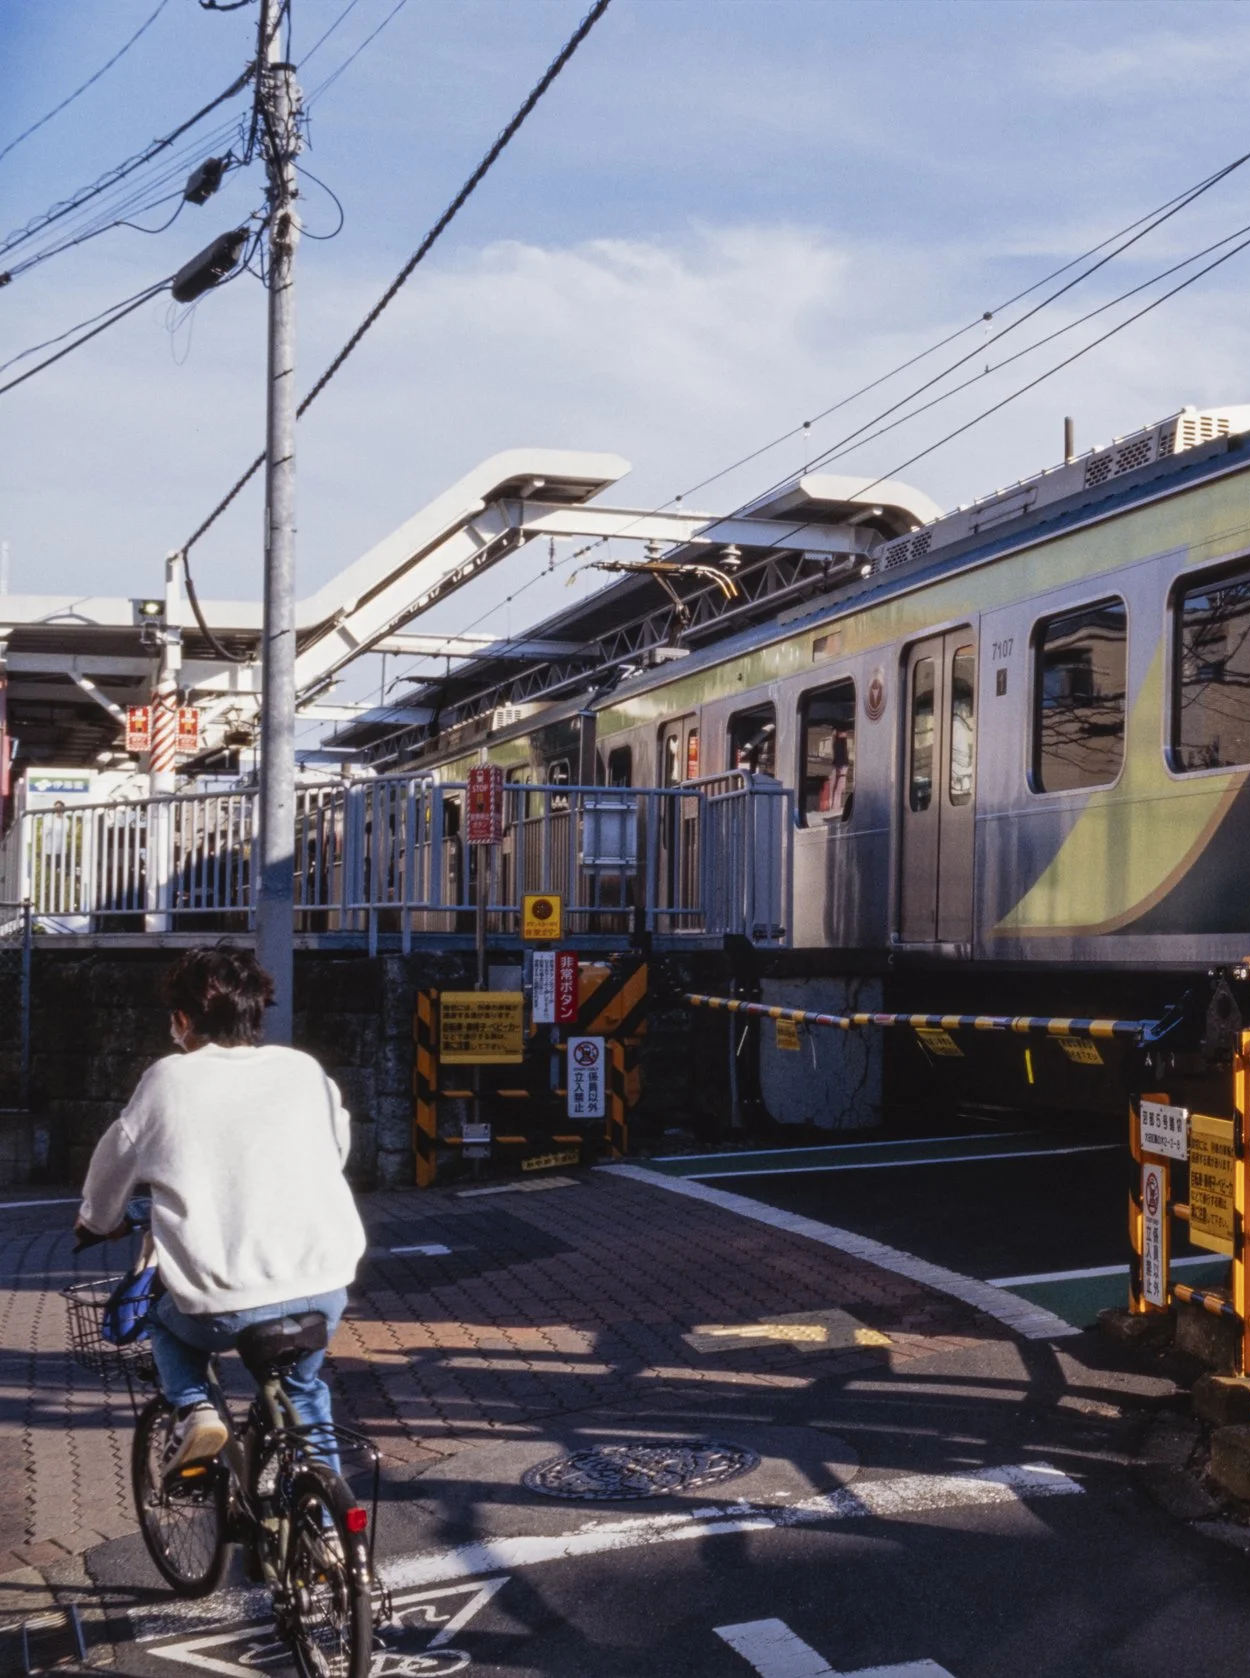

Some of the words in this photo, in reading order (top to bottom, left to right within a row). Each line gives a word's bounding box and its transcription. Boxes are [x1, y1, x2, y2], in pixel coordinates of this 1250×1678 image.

[991, 638, 1014, 661] 7107
[560, 956, 574, 1018] 非常ボタン
[574, 1072, 584, 1113] 立入禁止
[588, 1072, 599, 1112] 係員以外
